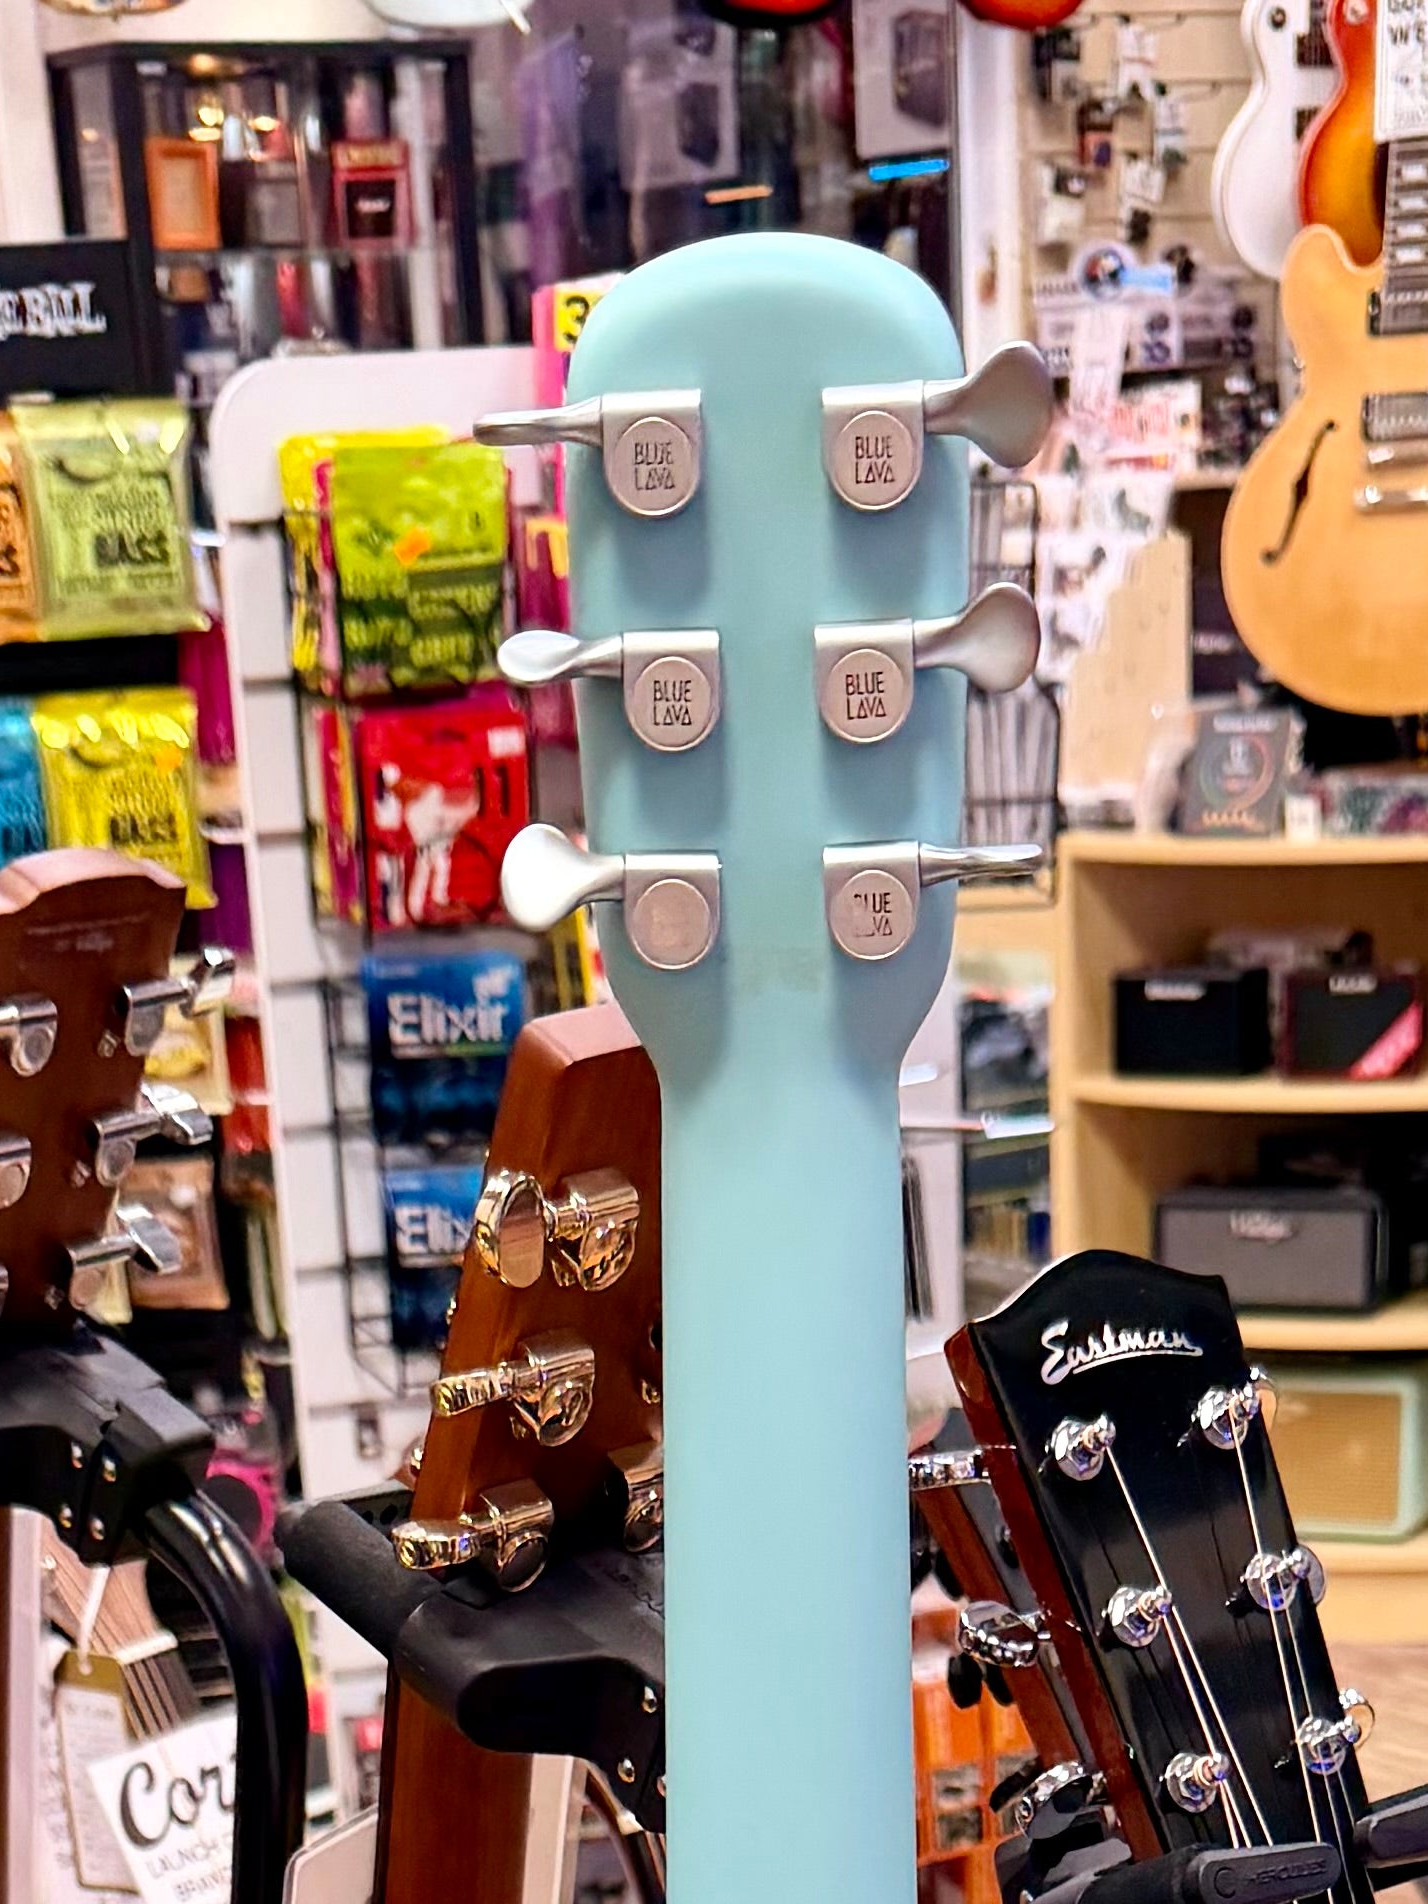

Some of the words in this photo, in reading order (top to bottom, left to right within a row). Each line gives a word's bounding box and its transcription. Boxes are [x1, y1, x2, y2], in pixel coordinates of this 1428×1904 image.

[634, 442, 674, 466] BLUE
[855, 436, 893, 460] BLUE
[634, 467, 675, 491] LAVA
[855, 461, 895, 484] LAVA
[653, 680, 692, 703] BLUE
[845, 671, 885, 695] BLUE
[653, 705, 692, 726] LAVA
[846, 697, 887, 720] LAVA
[388, 992, 508, 1045] Elixir
[1041, 1319, 1203, 1385] Eastman
